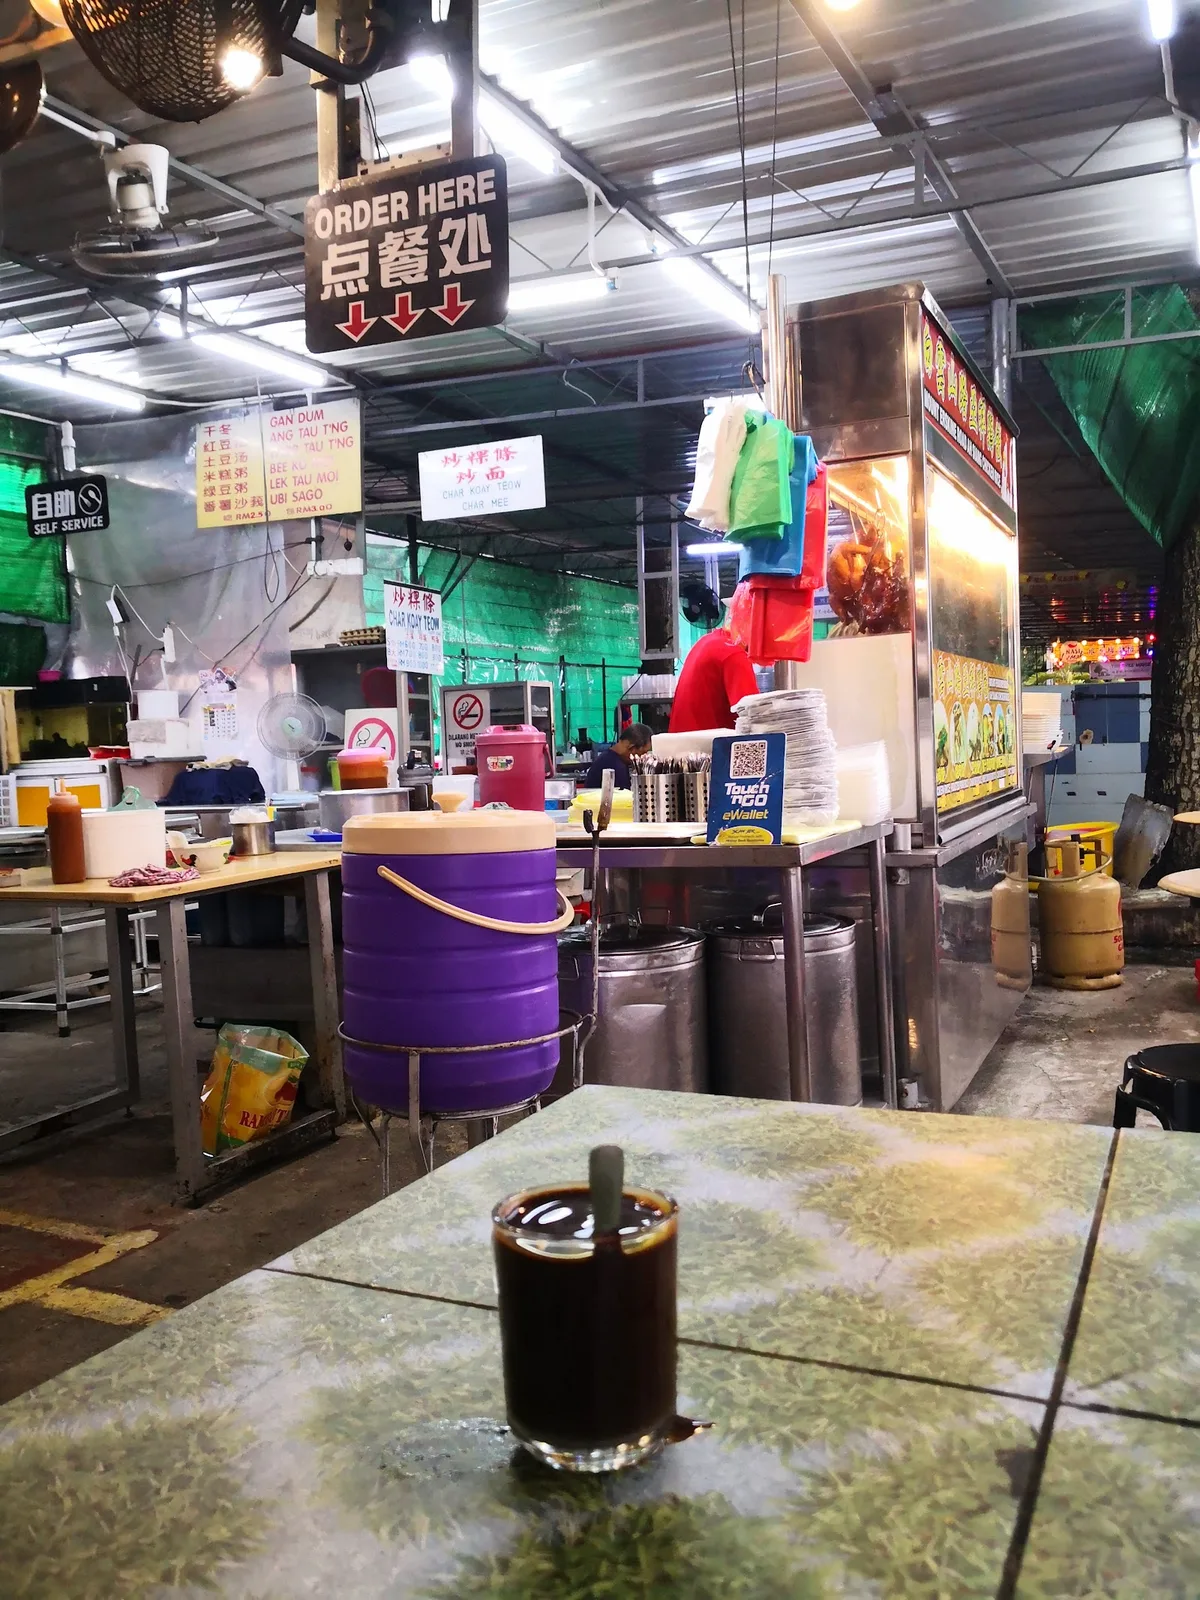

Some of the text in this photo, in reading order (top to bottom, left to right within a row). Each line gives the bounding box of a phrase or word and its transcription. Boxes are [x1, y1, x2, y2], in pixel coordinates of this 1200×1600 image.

[314, 168, 496, 239] ORDER HERE
[320, 212, 492, 301] 点餐处
[270, 409, 324, 428] GAN DUM
[270, 420, 349, 443] ANG TAU T'NG
[304, 440, 324, 453] TAU
[328, 435, 354, 450] T'NG
[270, 461, 288, 474] BEE
[456, 465, 505, 484] 炒面
[270, 469, 339, 489] LEK TAU MOI
[270, 488, 323, 505] UBI SAGO
[442, 479, 521, 500] CHAR KOAY TEOW
[31, 489, 76, 521] 自助
[462, 497, 509, 511] CHAR MEE
[34, 515, 104, 536] SELF SERVICE
[388, 609, 440, 631] CHAR KOAY TEOW
[724, 781, 770, 796] Touch
[722, 808, 769, 821] eWallet
